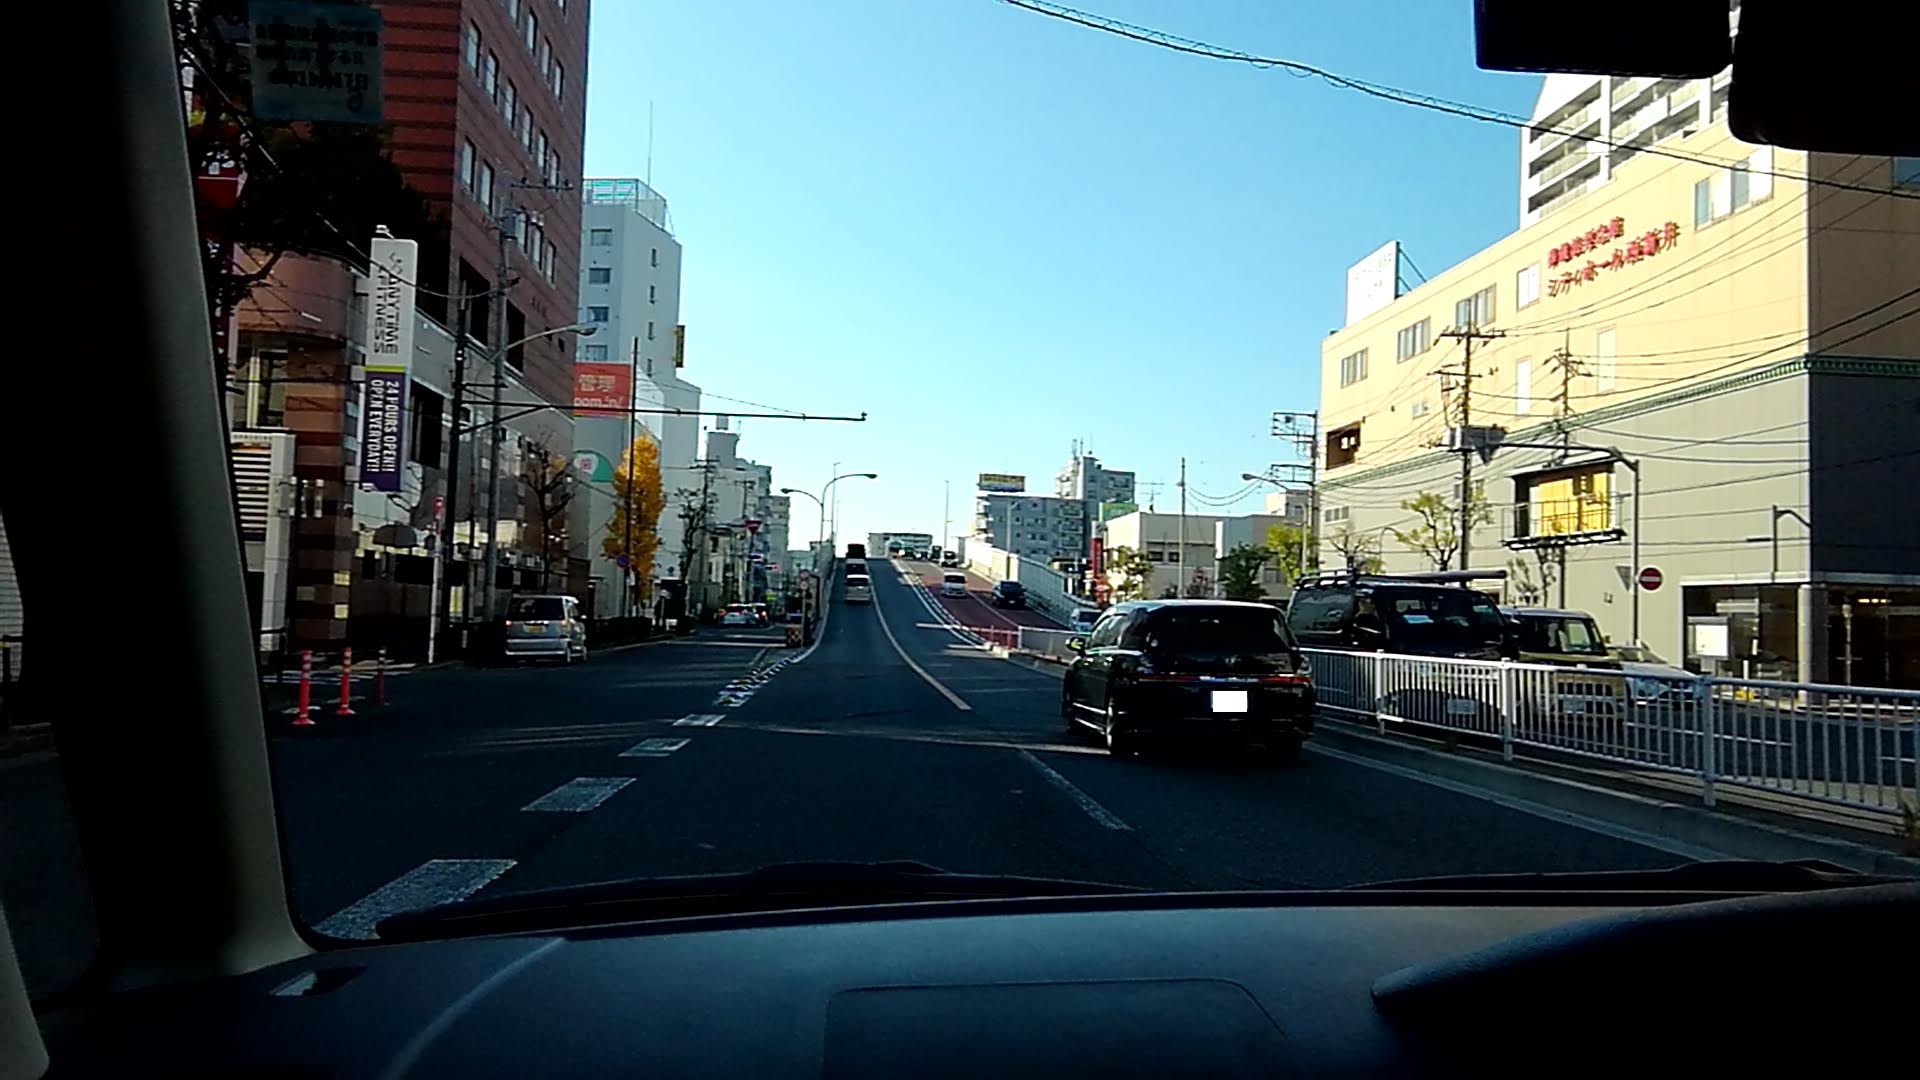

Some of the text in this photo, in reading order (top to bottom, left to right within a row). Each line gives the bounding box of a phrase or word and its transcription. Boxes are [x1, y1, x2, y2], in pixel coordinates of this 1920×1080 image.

[373, 274, 388, 354] FITNESS
[385, 272, 401, 354] ANYTIME
[386, 381, 400, 394] 24
[382, 435, 398, 473] OPEN!!
